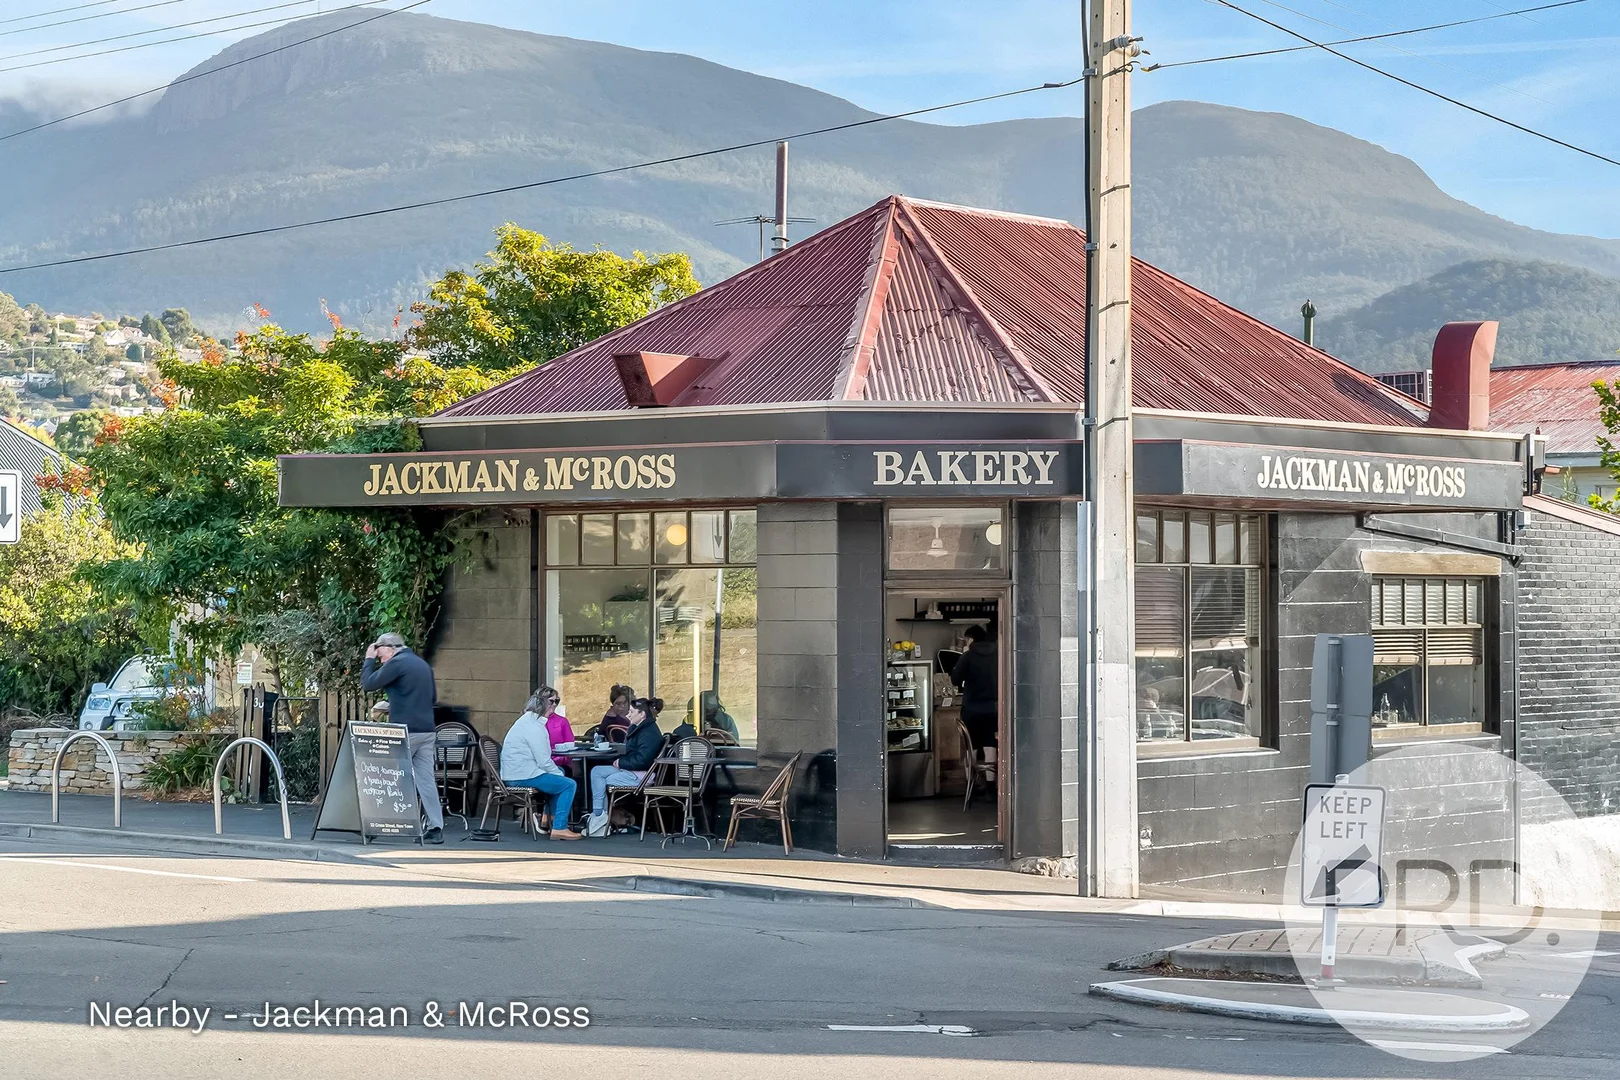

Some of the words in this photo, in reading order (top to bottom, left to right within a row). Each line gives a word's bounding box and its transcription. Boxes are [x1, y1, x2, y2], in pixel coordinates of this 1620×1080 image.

[363, 459, 520, 496] JACKMAN
[522, 467, 540, 491] &
[544, 453, 677, 490] McROSS
[872, 450, 1060, 485] BAKERY
[1257, 455, 1370, 493] JACKMAN
[1372, 470, 1384, 494] &
[1386, 463, 1466, 498] McROSS
[1320, 796, 1372, 814] KEEP
[1320, 821, 1368, 839] LEFT
